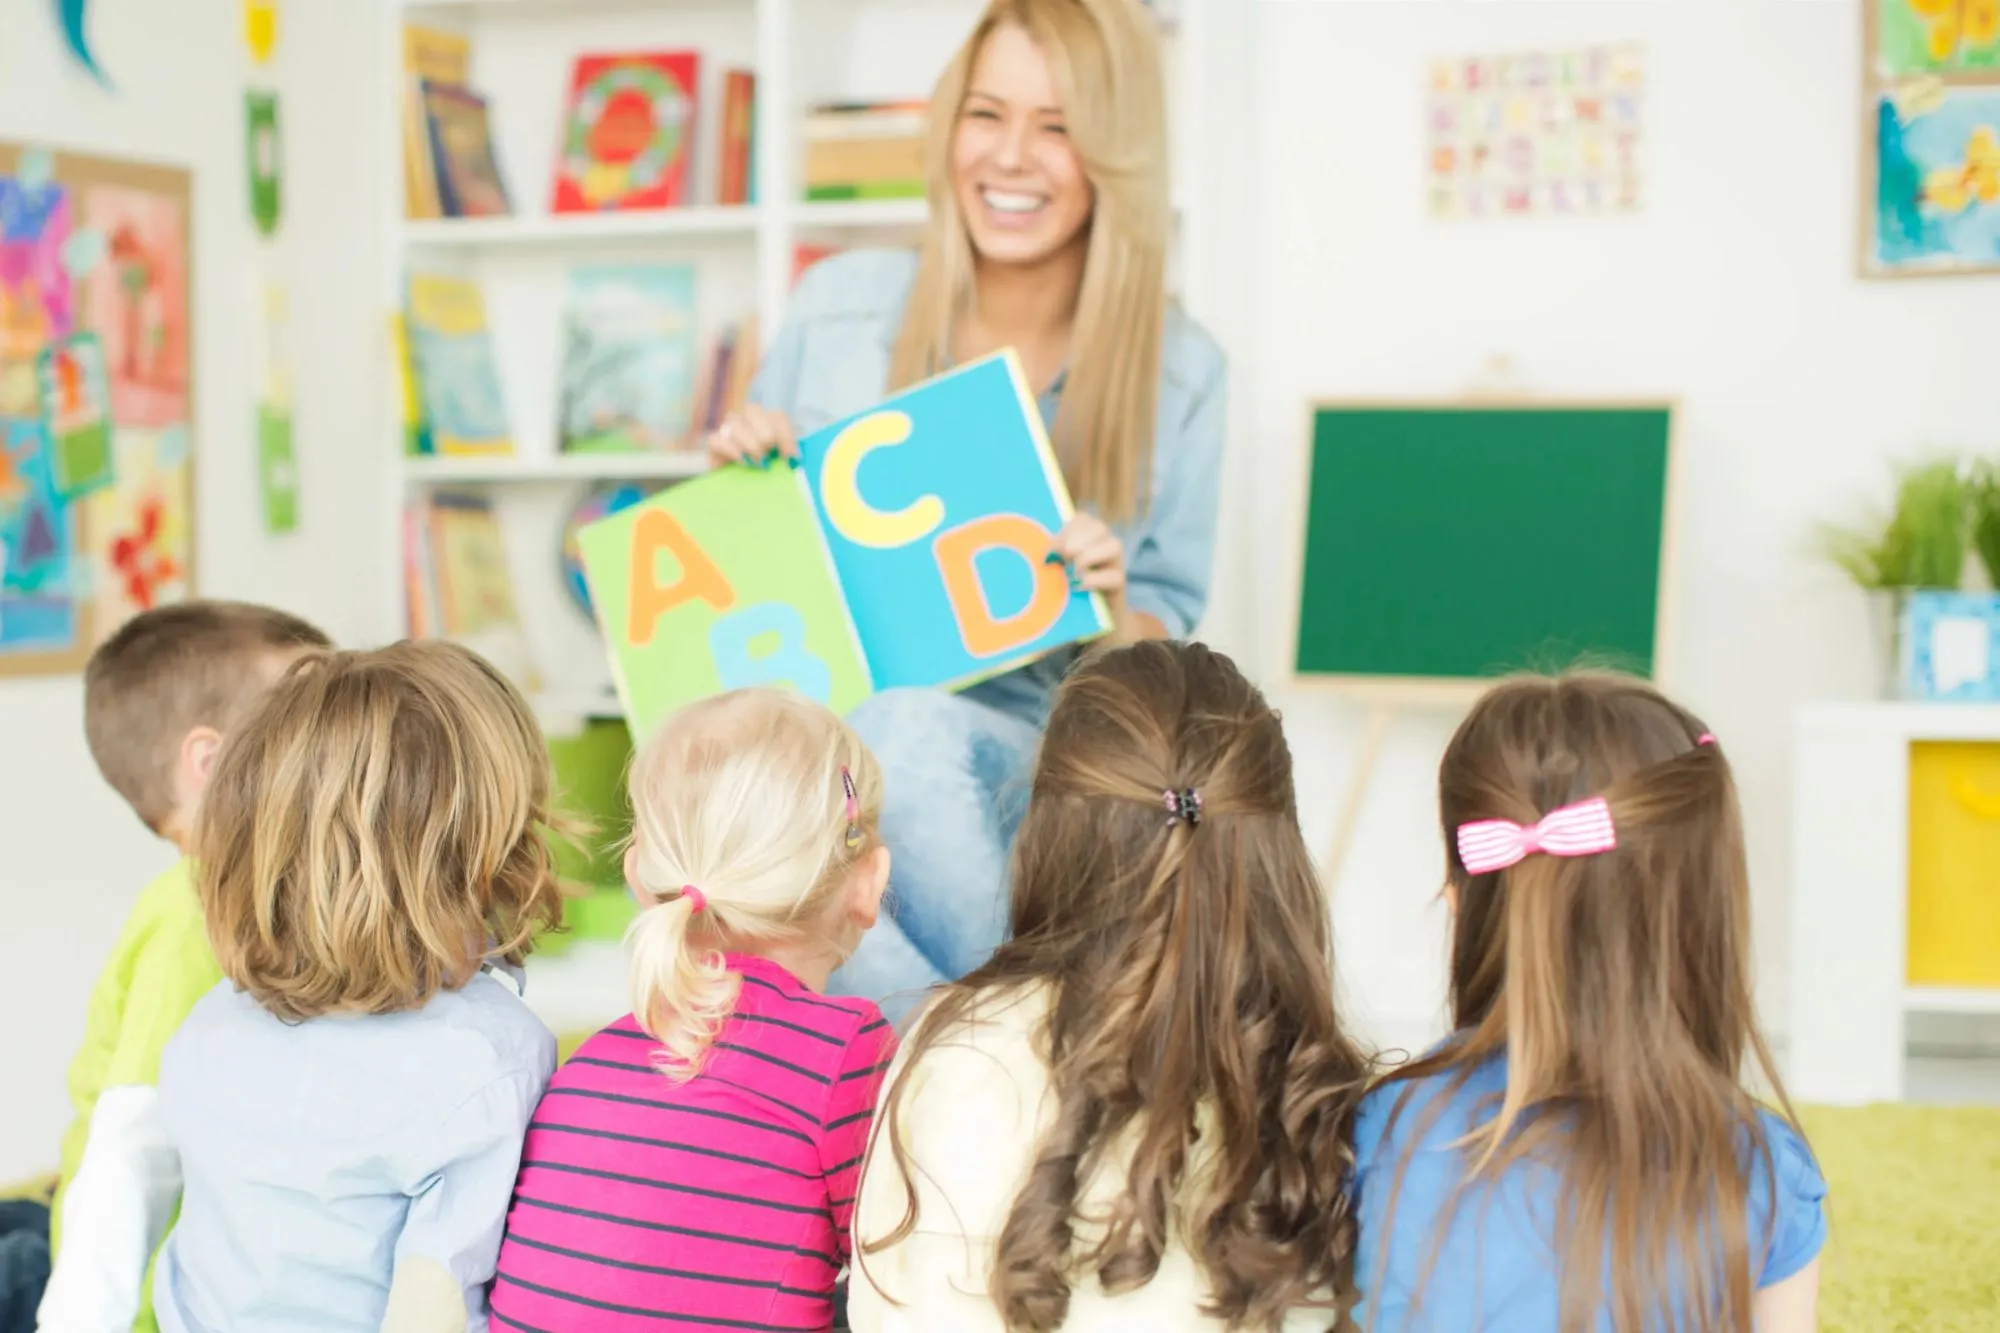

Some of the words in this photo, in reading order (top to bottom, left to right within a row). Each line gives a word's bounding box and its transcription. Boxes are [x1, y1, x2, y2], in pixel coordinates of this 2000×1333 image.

[823, 412, 944, 547] C
[627, 508, 735, 645] A
[933, 513, 1070, 658] D
[710, 602, 831, 703] B
